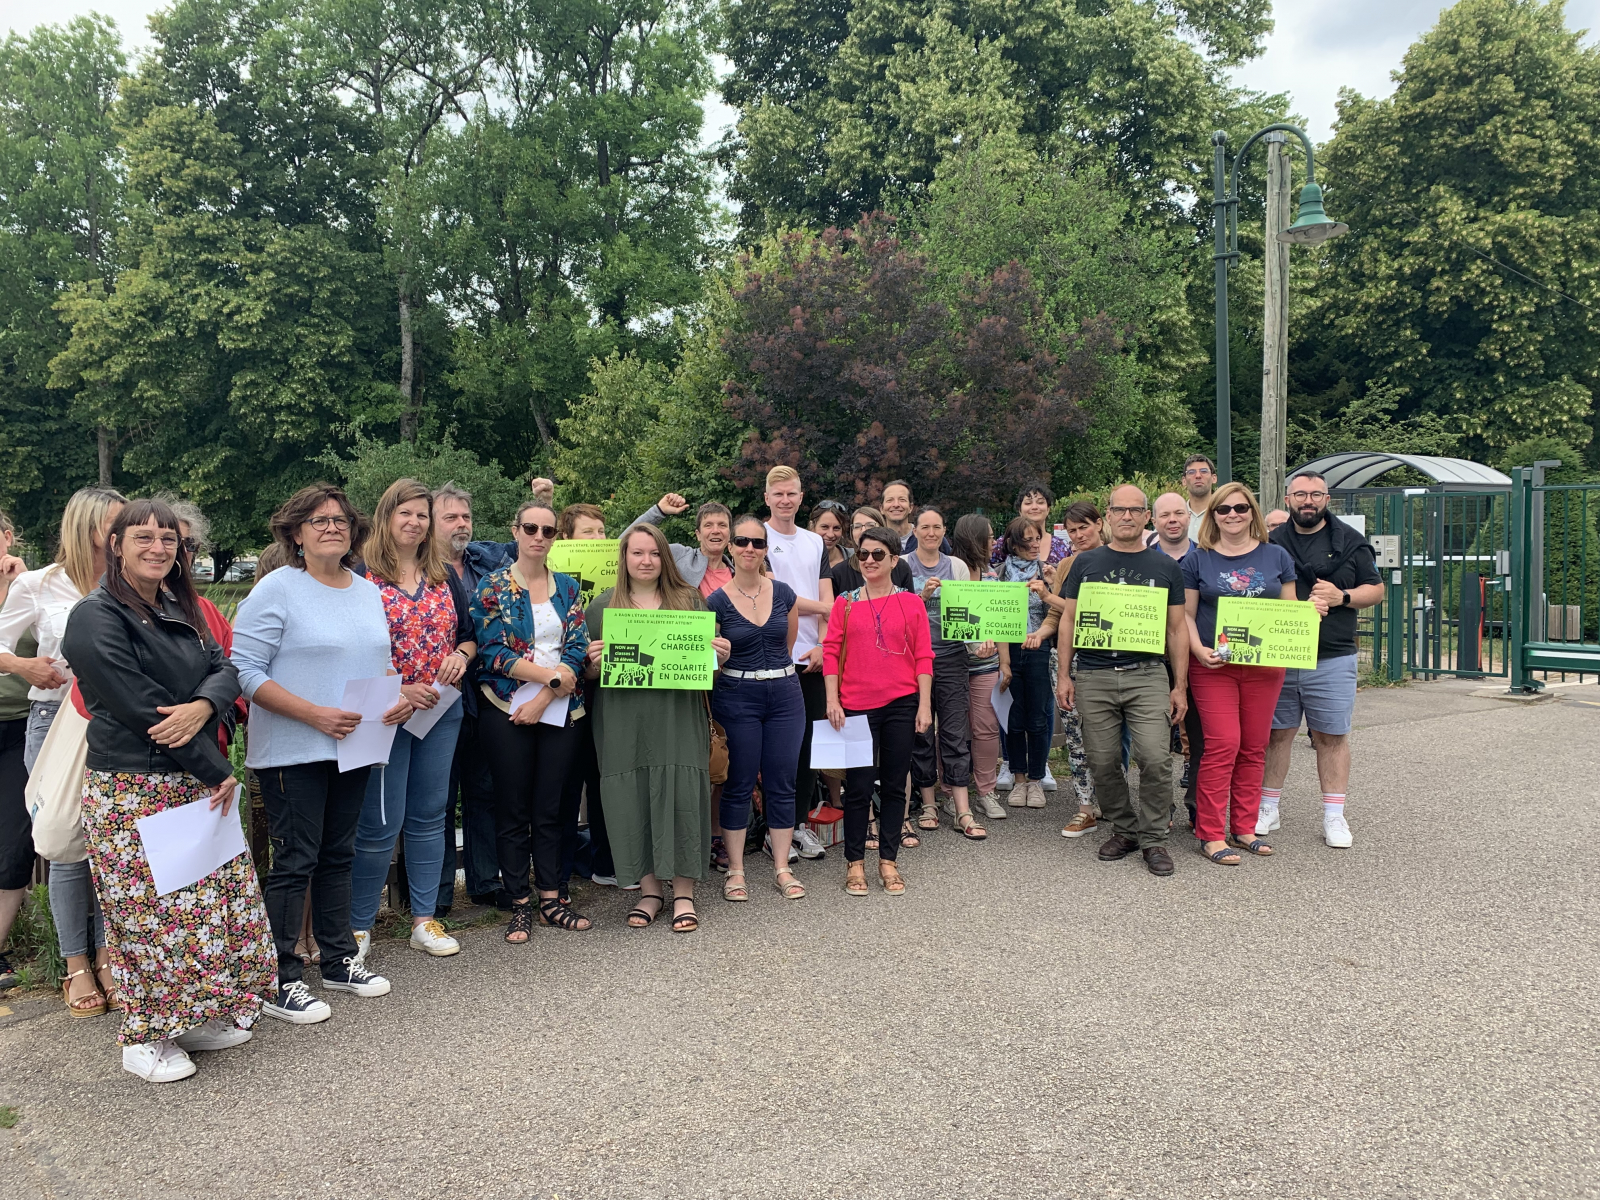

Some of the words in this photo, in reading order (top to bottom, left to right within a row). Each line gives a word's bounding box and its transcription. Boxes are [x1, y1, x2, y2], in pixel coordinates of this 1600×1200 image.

[1125, 604, 1157, 612] CLASSES
[1119, 611, 1158, 620] CHARGÉES
[1119, 628, 1159, 637] SCOLARITÉ
[1269, 627, 1310, 635] CHARGÉES
[661, 641, 705, 651] CHARGÉES
[1130, 637, 1160, 646] DANGER
[1268, 644, 1311, 653] SCOLARITÉ
[661, 663, 707, 671] SCOLARITÉ
